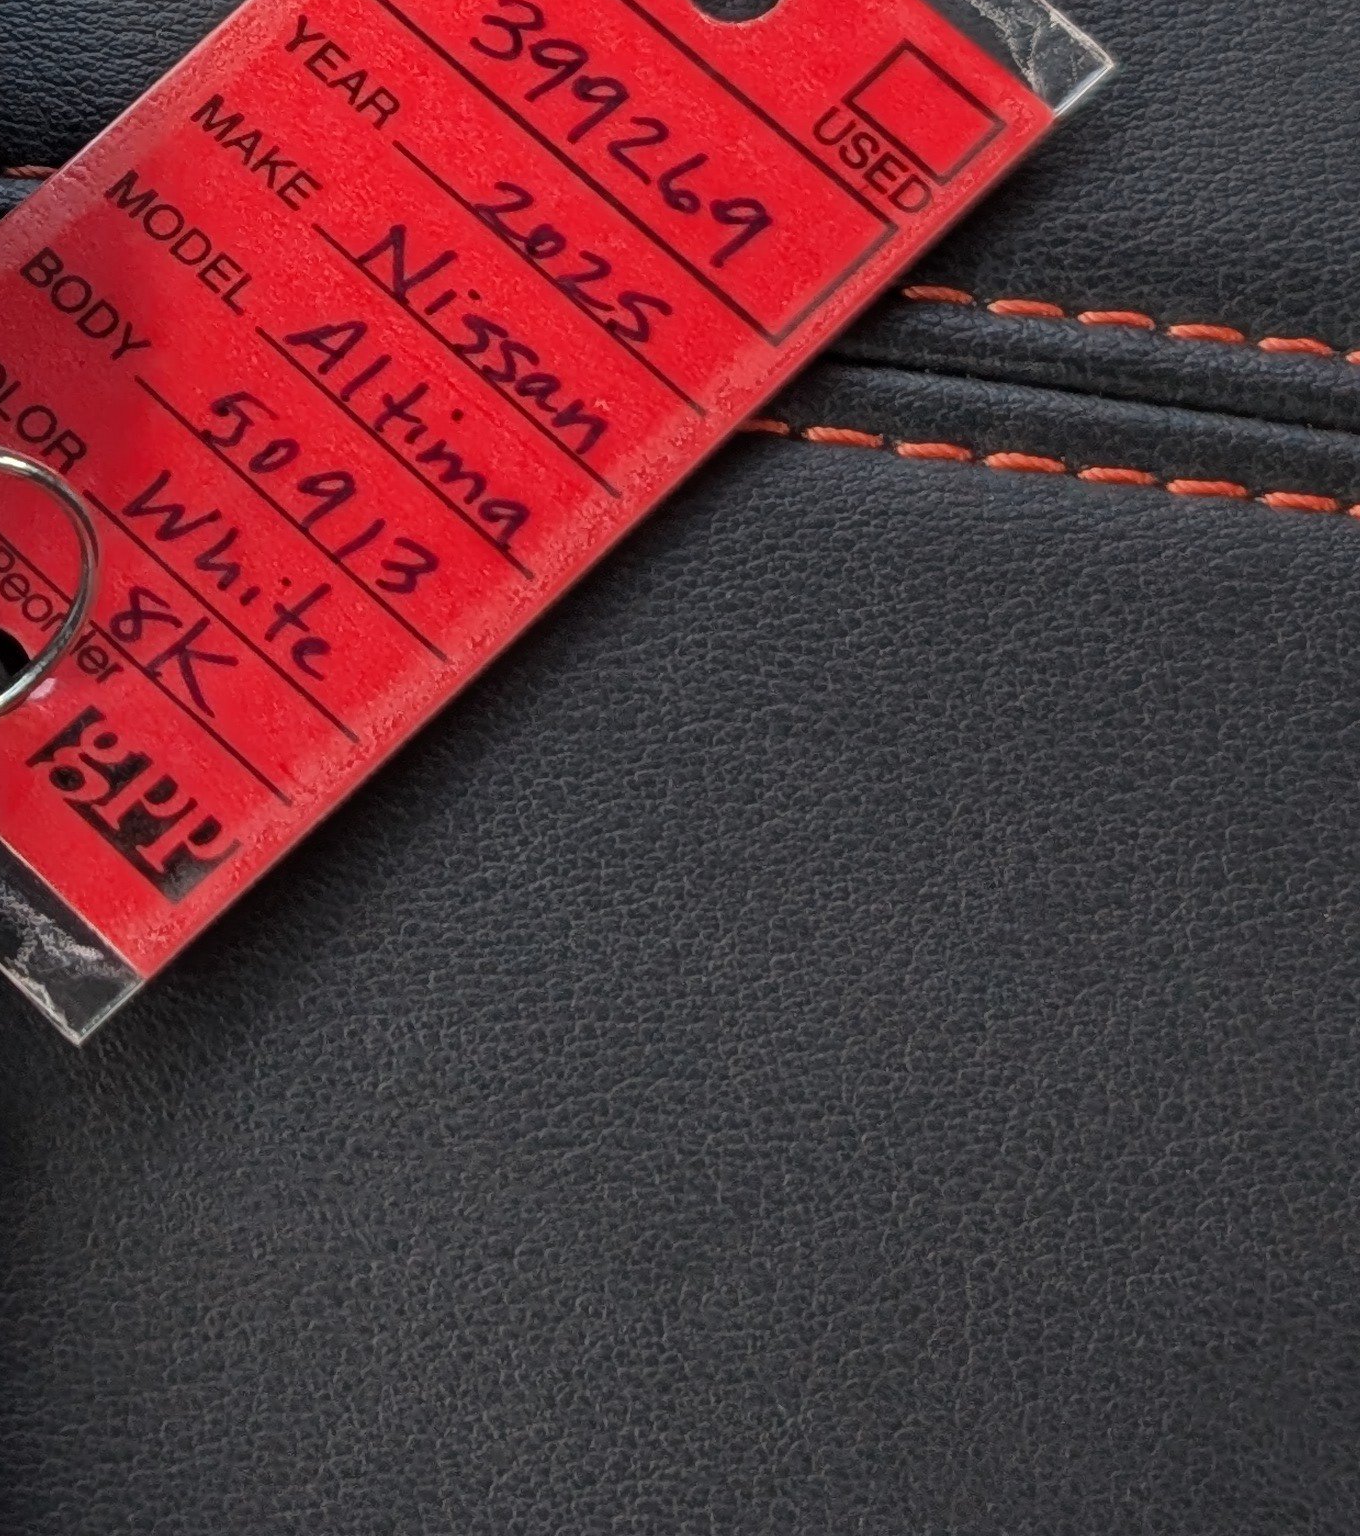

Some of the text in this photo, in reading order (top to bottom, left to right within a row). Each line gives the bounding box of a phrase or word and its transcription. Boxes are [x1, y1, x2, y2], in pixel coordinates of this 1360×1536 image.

[190, 94, 609, 455] MAKE Nissan
[283, 14, 674, 345] YEAR 2025
[812, 105, 935, 214] USED
[19, 245, 438, 594] BODY 50913
[104, 169, 531, 554] MODEL Altima
[109, 583, 240, 719] 8K
[122, 470, 332, 681] White
